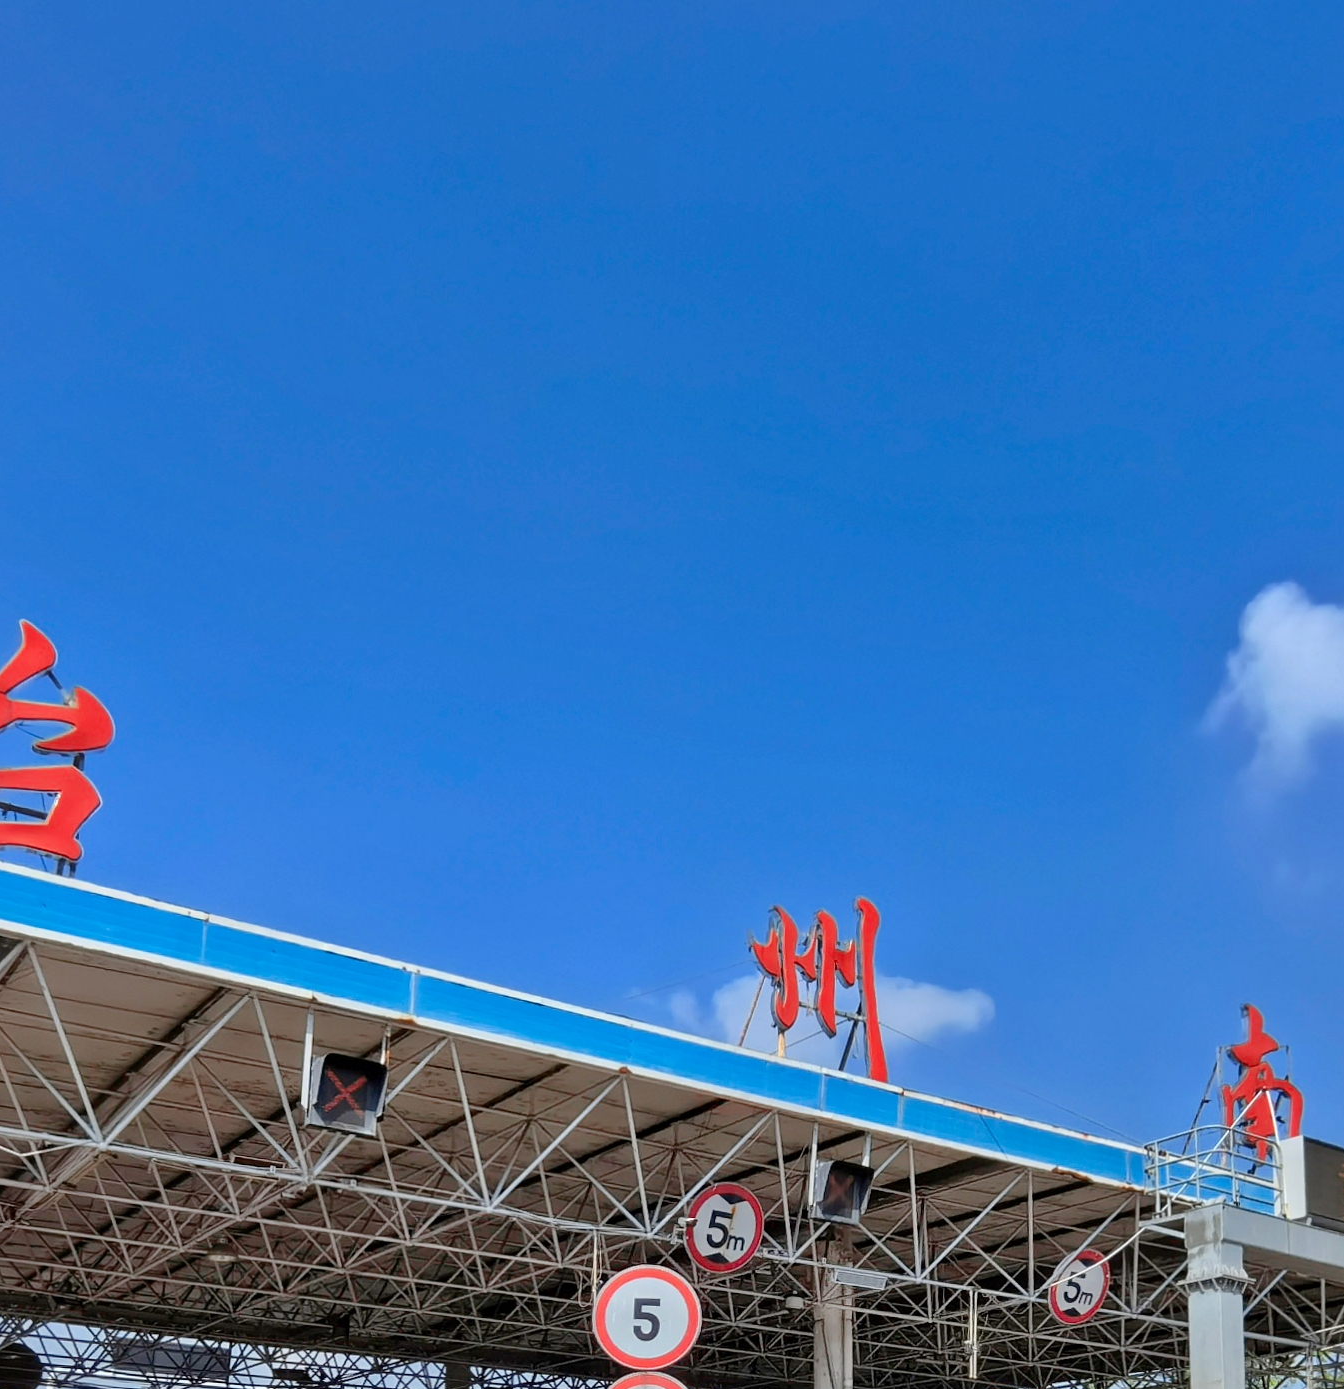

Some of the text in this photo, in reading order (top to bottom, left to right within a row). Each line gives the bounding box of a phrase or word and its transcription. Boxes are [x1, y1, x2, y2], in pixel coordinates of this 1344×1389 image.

[750, 897, 888, 1083] 州
[1223, 1003, 1303, 1167] 南
[707, 1209, 746, 1251] 5m
[1063, 1271, 1094, 1305] 5m
[633, 1298, 661, 1341] 5
